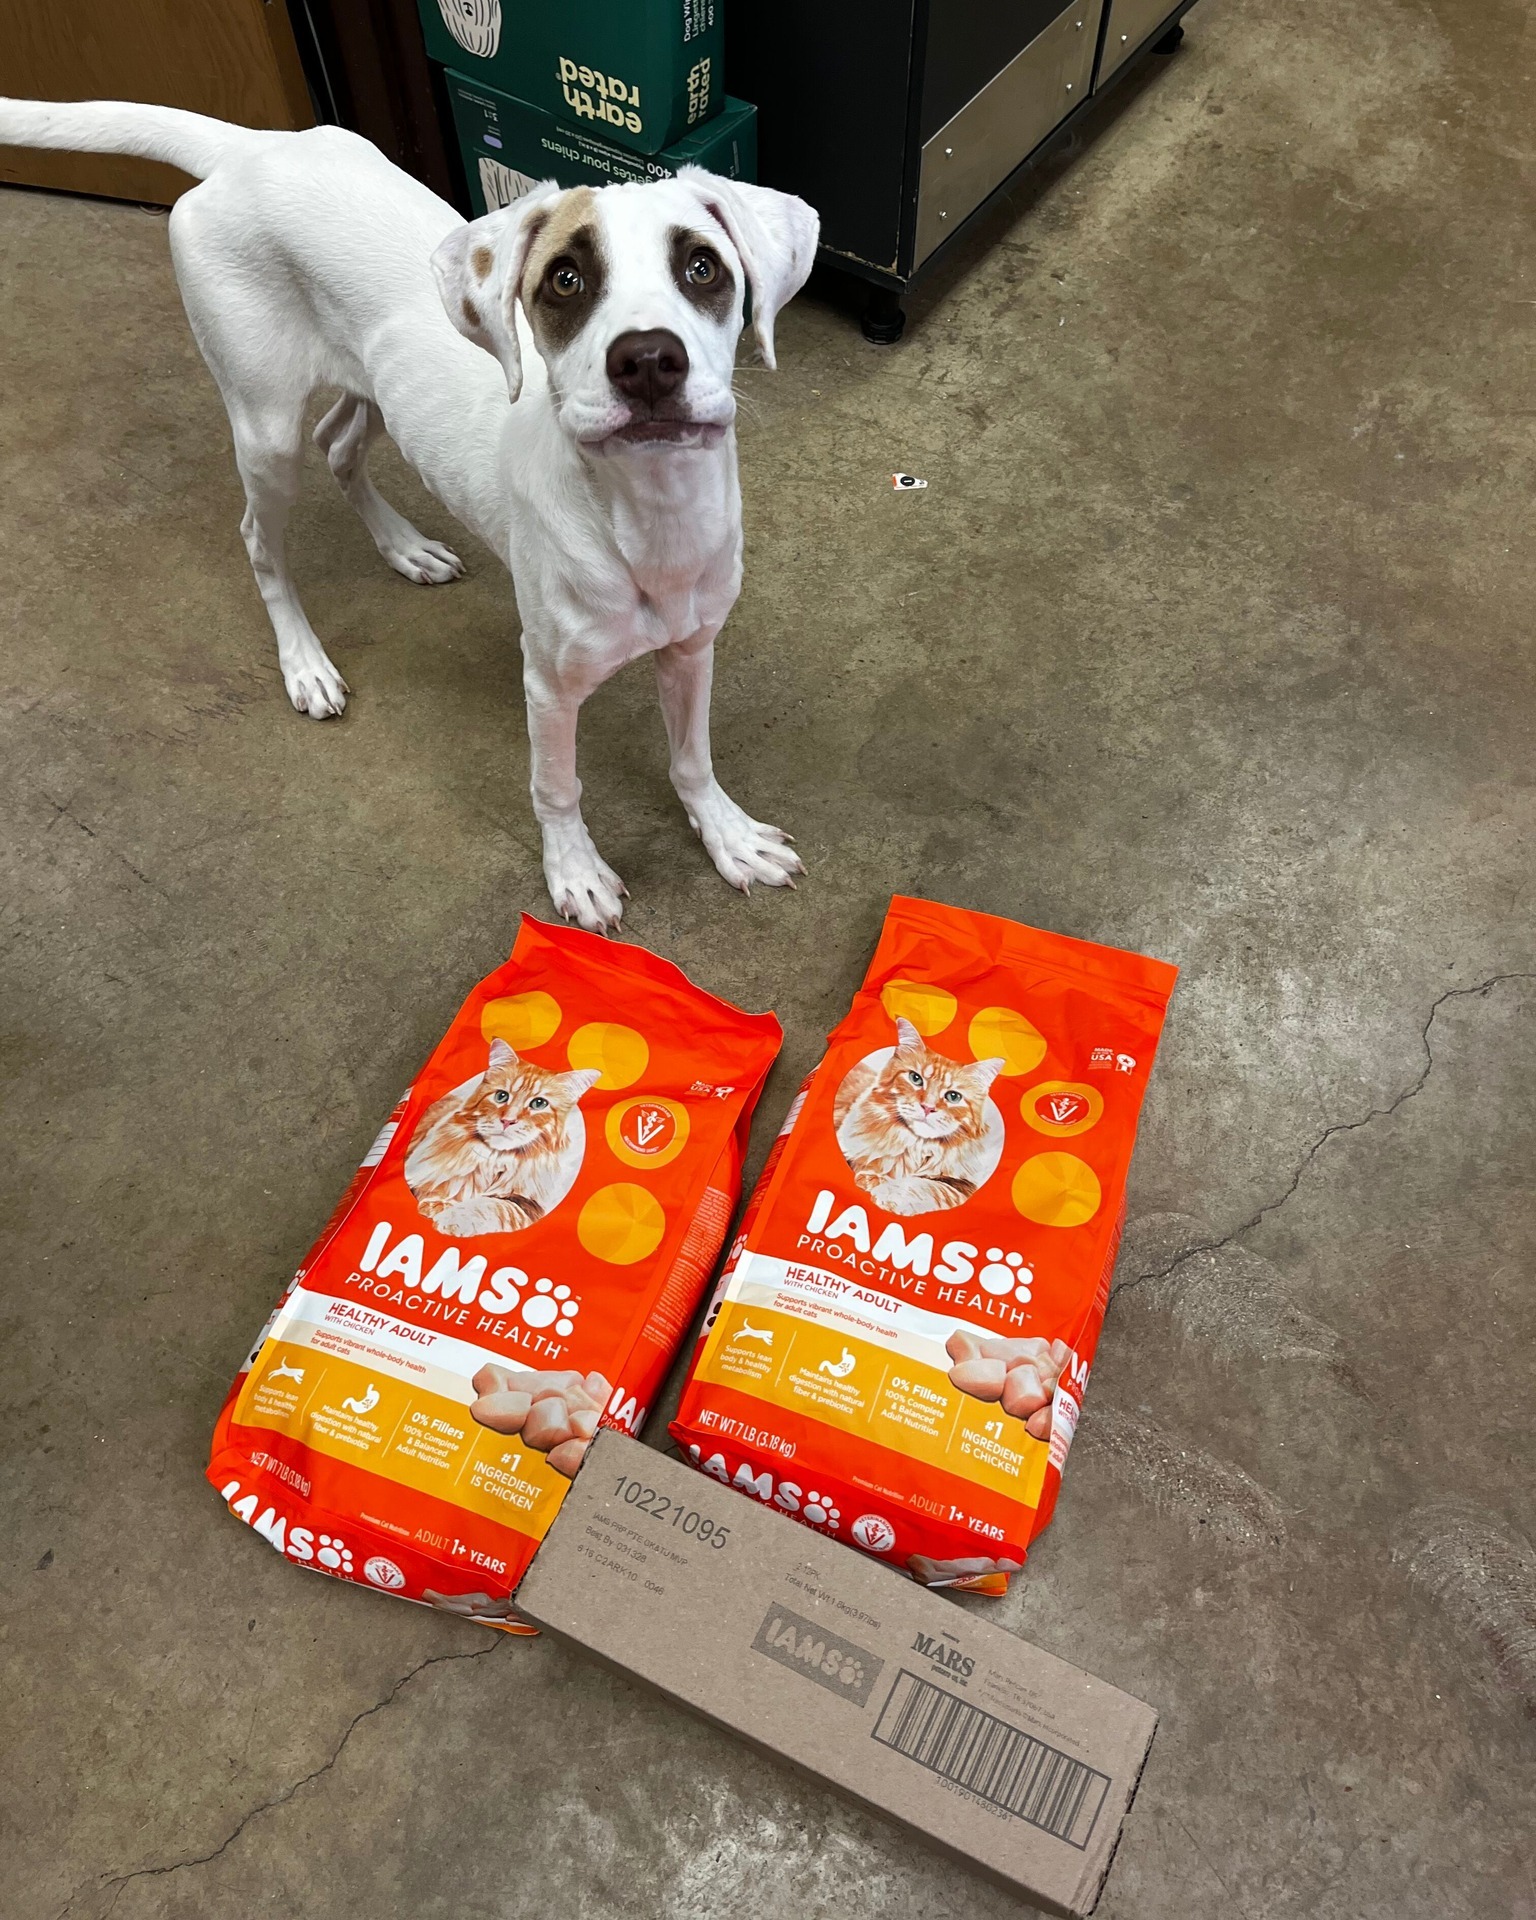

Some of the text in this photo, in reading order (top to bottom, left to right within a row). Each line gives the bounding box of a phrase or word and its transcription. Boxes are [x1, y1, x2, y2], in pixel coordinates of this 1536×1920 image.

[558, 56, 640, 107] rated
[687, 64, 701, 124] earth
[697, 57, 711, 120] rated
[562, 84, 643, 134] earth
[540, 137, 580, 162] chiens
[581, 153, 611, 174] pour
[646, 161, 672, 179] 400
[1091, 1053, 1113, 1061] USA
[805, 1189, 979, 1285] IAMS
[359, 1221, 529, 1314] IAMS
[796, 1233, 928, 1296] PROACTIVE
[344, 1272, 471, 1326] PROACTIVE
[783, 1279, 839, 1300] WITH CHICKEN
[785, 1266, 903, 1314] HEALTHY ADULT
[328, 1302, 438, 1347] HEALTHY ADULT
[773, 1299, 818, 1319] for adult cats
[776, 1292, 898, 1339] Supports vibrant whole-body health
[324, 1314, 376, 1336] WITH CHICKEN
[310, 1337, 351, 1356] for adult cats
[314, 1329, 427, 1374] Supports vibrant whole-body health
[724, 1344, 773, 1363] Supports lean
[719, 1354, 737, 1365] body
[744, 1359, 772, 1374] healthy
[721, 1363, 763, 1380] metabolism
[258, 1384, 299, 1402] Supports lean
[788, 1374, 866, 1408] digestion with natural
[799, 1367, 861, 1397] Maintains healthy
[891, 1376, 948, 1407] 0% Fillers
[253, 1393, 297, 1412] body & healthy
[792, 1385, 855, 1415] fiber & prebiotics
[884, 1389, 946, 1419] 100% Complete
[890, 1402, 936, 1424] & Balanced
[310, 1411, 382, 1444] digestion with natural
[322, 1404, 379, 1433] Maintains healthy
[411, 1411, 465, 1440] 0% Fillers
[698, 1408, 797, 1459] NET WT 7 LB (3.18 kg)
[880, 1408, 940, 1437] Adult Nutrition
[984, 1420, 1004, 1440] #1
[312, 1422, 370, 1451] fiber & prebiotics
[402, 1423, 460, 1452] 100% Complete
[406, 1436, 449, 1458] & Balanced
[961, 1427, 1025, 1466] INGREDIENT
[249, 1451, 269, 1467] NET
[266, 1457, 278, 1475] WT
[276, 1462, 282, 1475] 7
[279, 1465, 290, 1481] LB
[395, 1443, 450, 1470] Adult Nutrition
[500, 1452, 522, 1473] #1
[960, 1441, 1020, 1477] IS CHICKEN
[470, 1474, 534, 1511] IS CHICKEN
[473, 1460, 543, 1499] INGREDIENT
[689, 1444, 803, 1512] IAMS
[613, 1475, 731, 1550] 10221095
[852, 1475, 1005, 1541] Premium Cat Nutrition ADULT 1+ YEARS
[414, 1528, 451, 1551] ADULT
[451, 1538, 467, 1555] 1+
[469, 1549, 507, 1575] YEARS
[585, 1525, 647, 1564] Best By 031328
[593, 1512, 611, 1526] IAMS
[611, 1521, 627, 1534] PRP
[628, 1530, 644, 1544] PTE
[669, 1552, 688, 1566] MVP
[785, 1573, 803, 1588] Total
[803, 1583, 818, 1596] Net
[765, 1617, 843, 1676] IAMS
[910, 1631, 976, 1678] MARS
[935, 1776, 1014, 1823] 10019014802361
